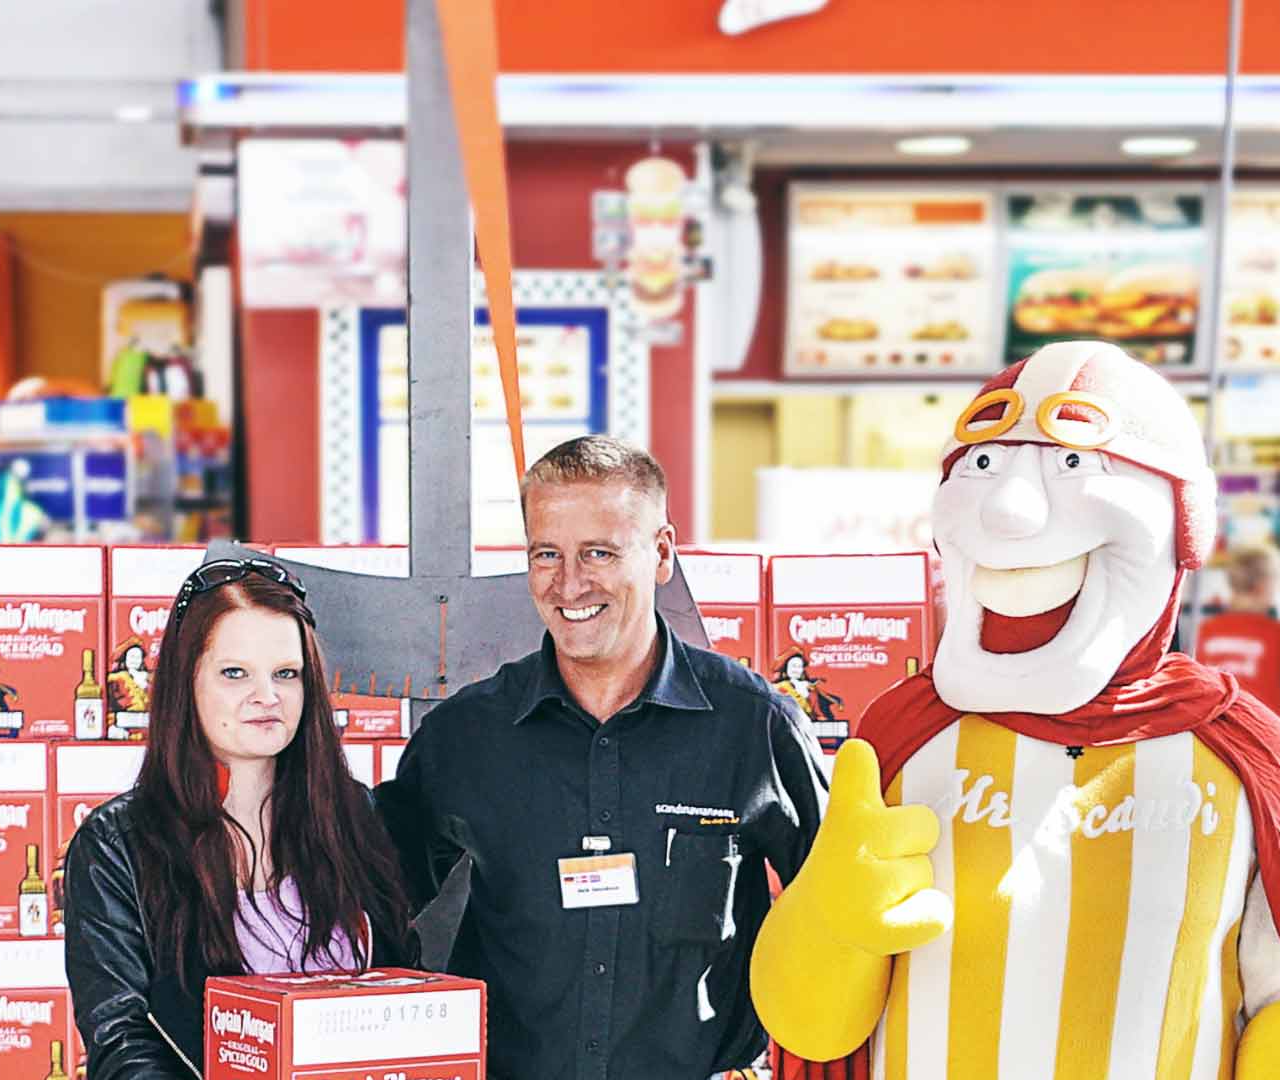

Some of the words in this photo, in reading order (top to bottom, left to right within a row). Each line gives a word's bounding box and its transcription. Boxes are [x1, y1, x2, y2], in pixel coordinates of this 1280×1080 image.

[19, 602, 86, 633] Morgan
[789, 613, 846, 643] Captain
[844, 612, 910, 641] Morgan
[28, 641, 64, 656] GOLD
[852, 651, 888, 664] GOLD
[212, 1005, 242, 1034] Captain
[239, 1010, 275, 1045] Morgan
[218, 1048, 246, 1065] SPICED
[246, 1054, 268, 1073] GOLD
